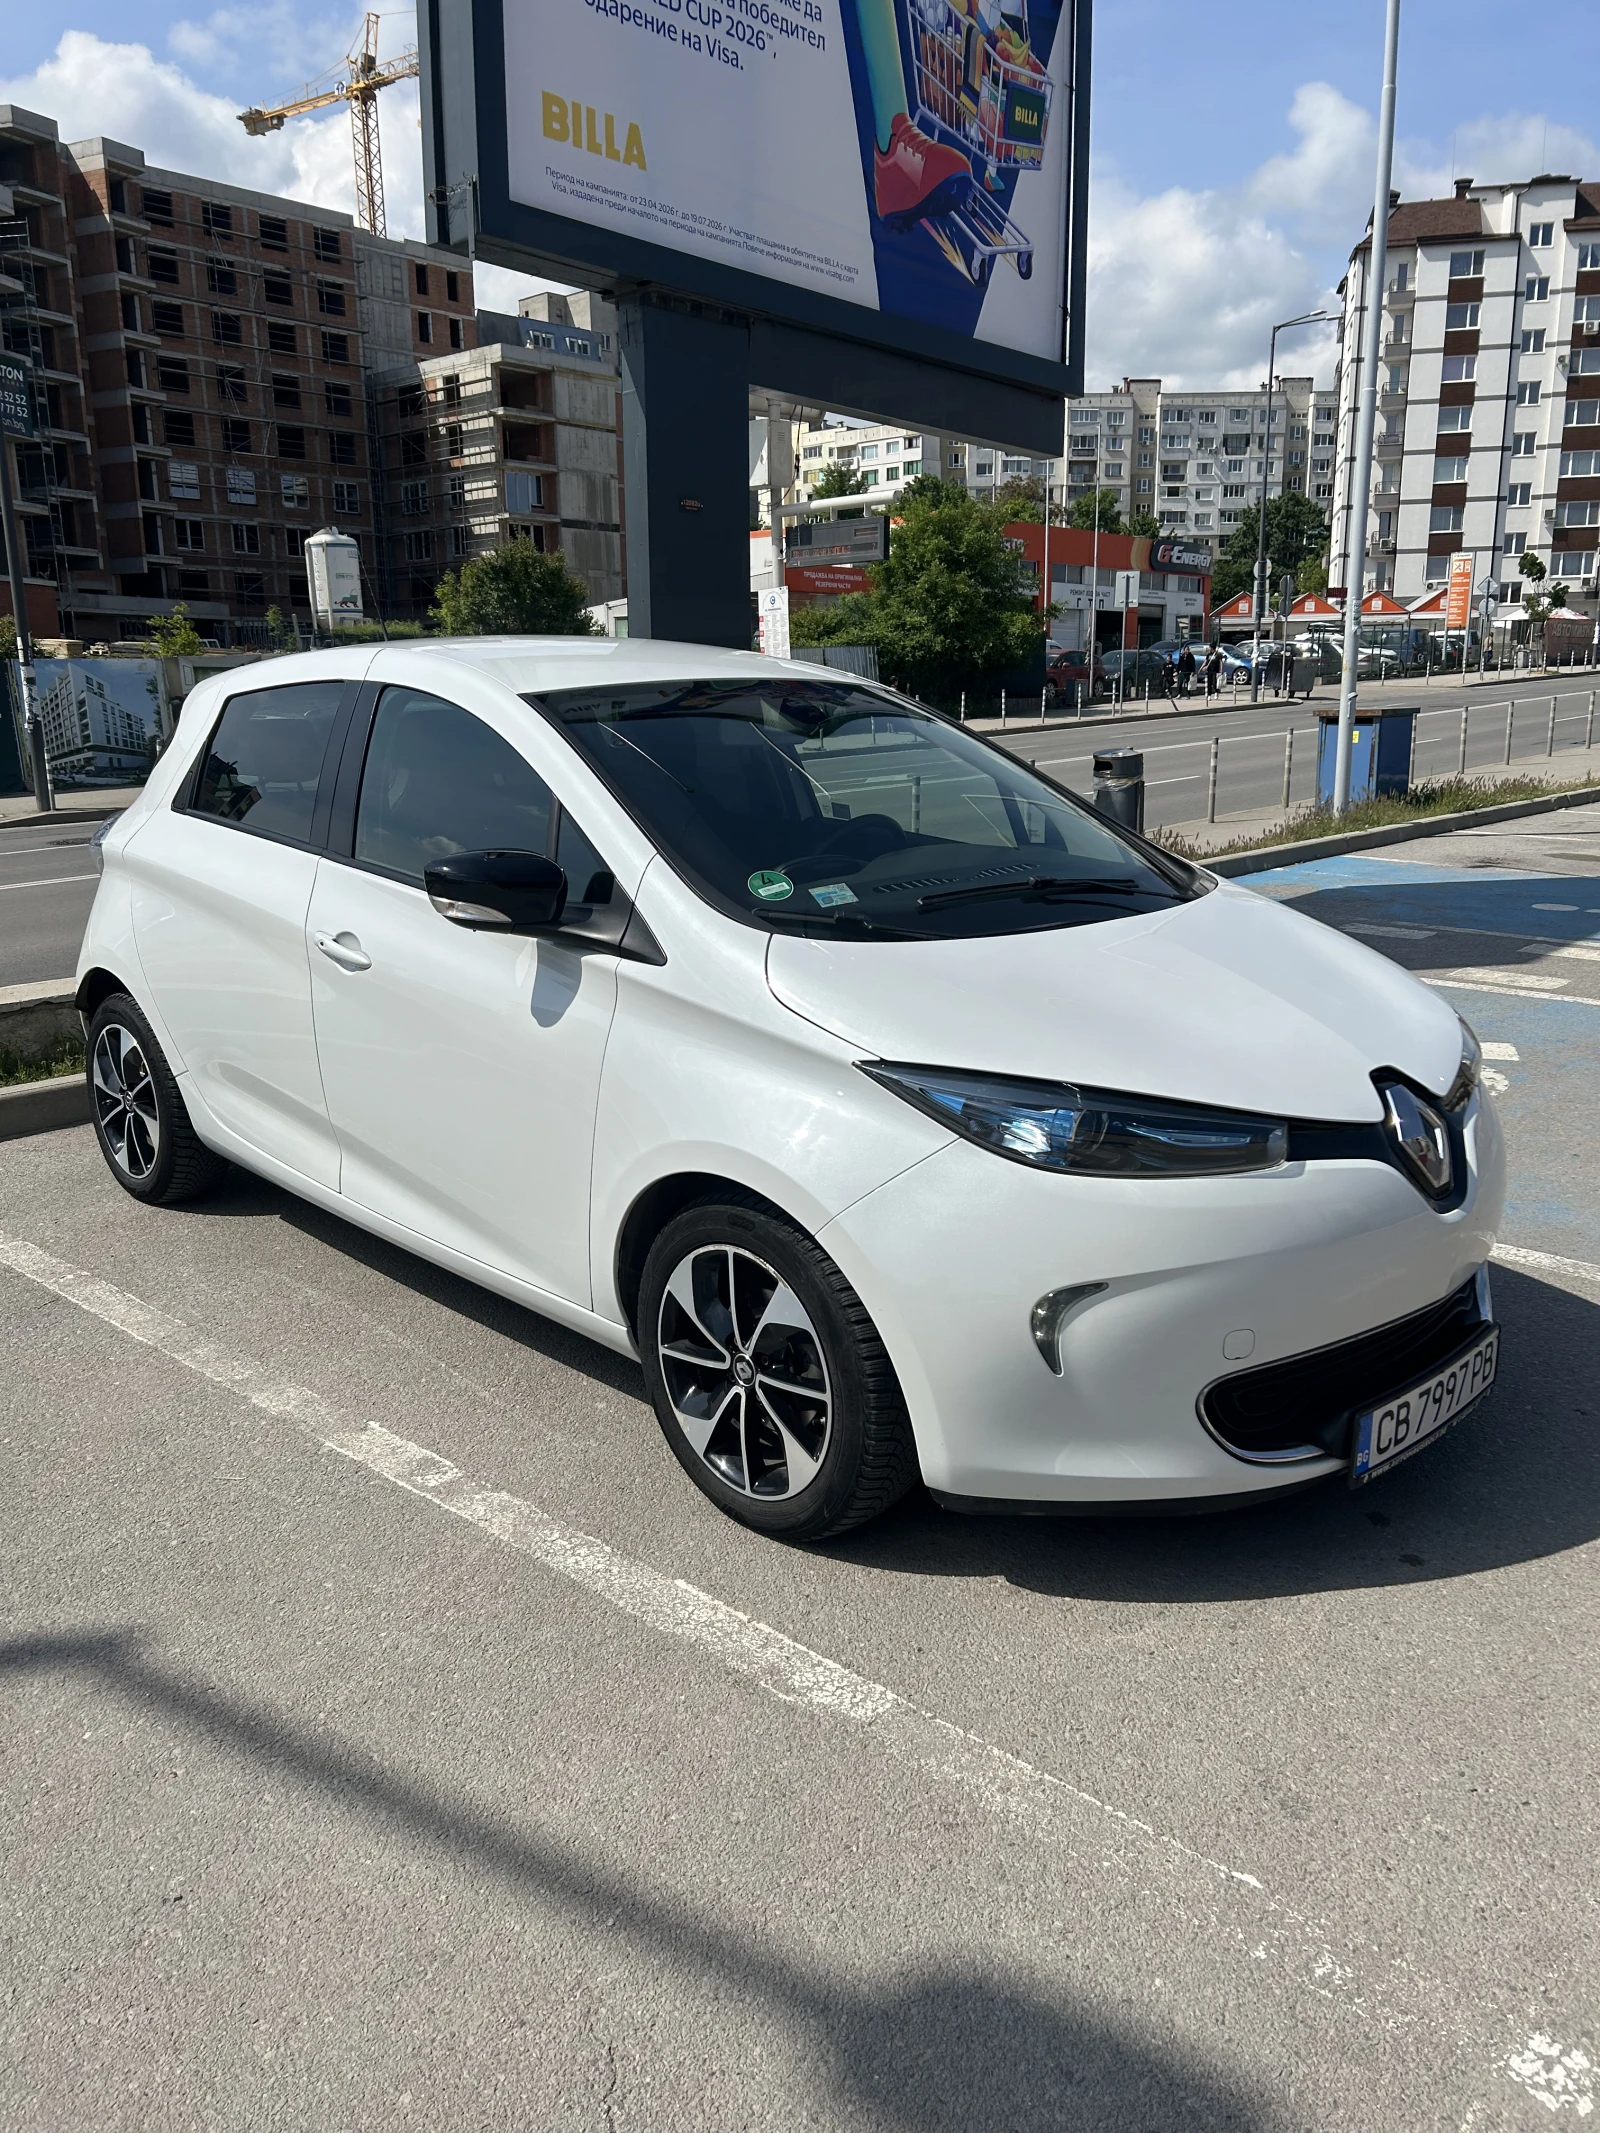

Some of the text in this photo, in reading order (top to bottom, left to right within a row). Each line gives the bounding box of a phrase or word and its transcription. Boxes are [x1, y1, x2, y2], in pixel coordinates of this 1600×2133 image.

[686, 0, 722, 29] CUP
[803, 1, 822, 23] да
[739, 0, 826, 51] победител
[682, 27, 701, 52] на
[705, 34, 744, 71] Visa.
[1014, 105, 1038, 126] BILLA
[541, 89, 647, 171] BILLA
[545, 166, 576, 186] Период
[576, 177, 585, 187] на
[585, 181, 629, 201] кампанията:
[630, 195, 638, 204] от
[638, 196, 675, 216] 23.04.2026
[681, 212, 690, 222] до
[690, 213, 723, 231] 19.07.2026
[728, 225, 756, 243] Участват
[756, 235, 786, 251] плащания
[791, 243, 817, 262] обектите
[824, 255, 840, 269] BILLA
[844, 263, 859, 276] карта
[551, 180, 569, 195] Visa,
[569, 188, 604, 206] издадена
[604, 199, 627, 213] преди
[627, 206, 659, 222] началото
[668, 218, 697, 235] периода
[765, 250, 803, 268] информация
[4, 391, 15, 403] 52
[15, 395, 27, 405] 52
[16, 406, 29, 418] 52
[803, 570, 863, 582] ПРОДАЖБА НА ОРИГИНАЛНИ
[1356, 1449, 1369, 1467] BG
